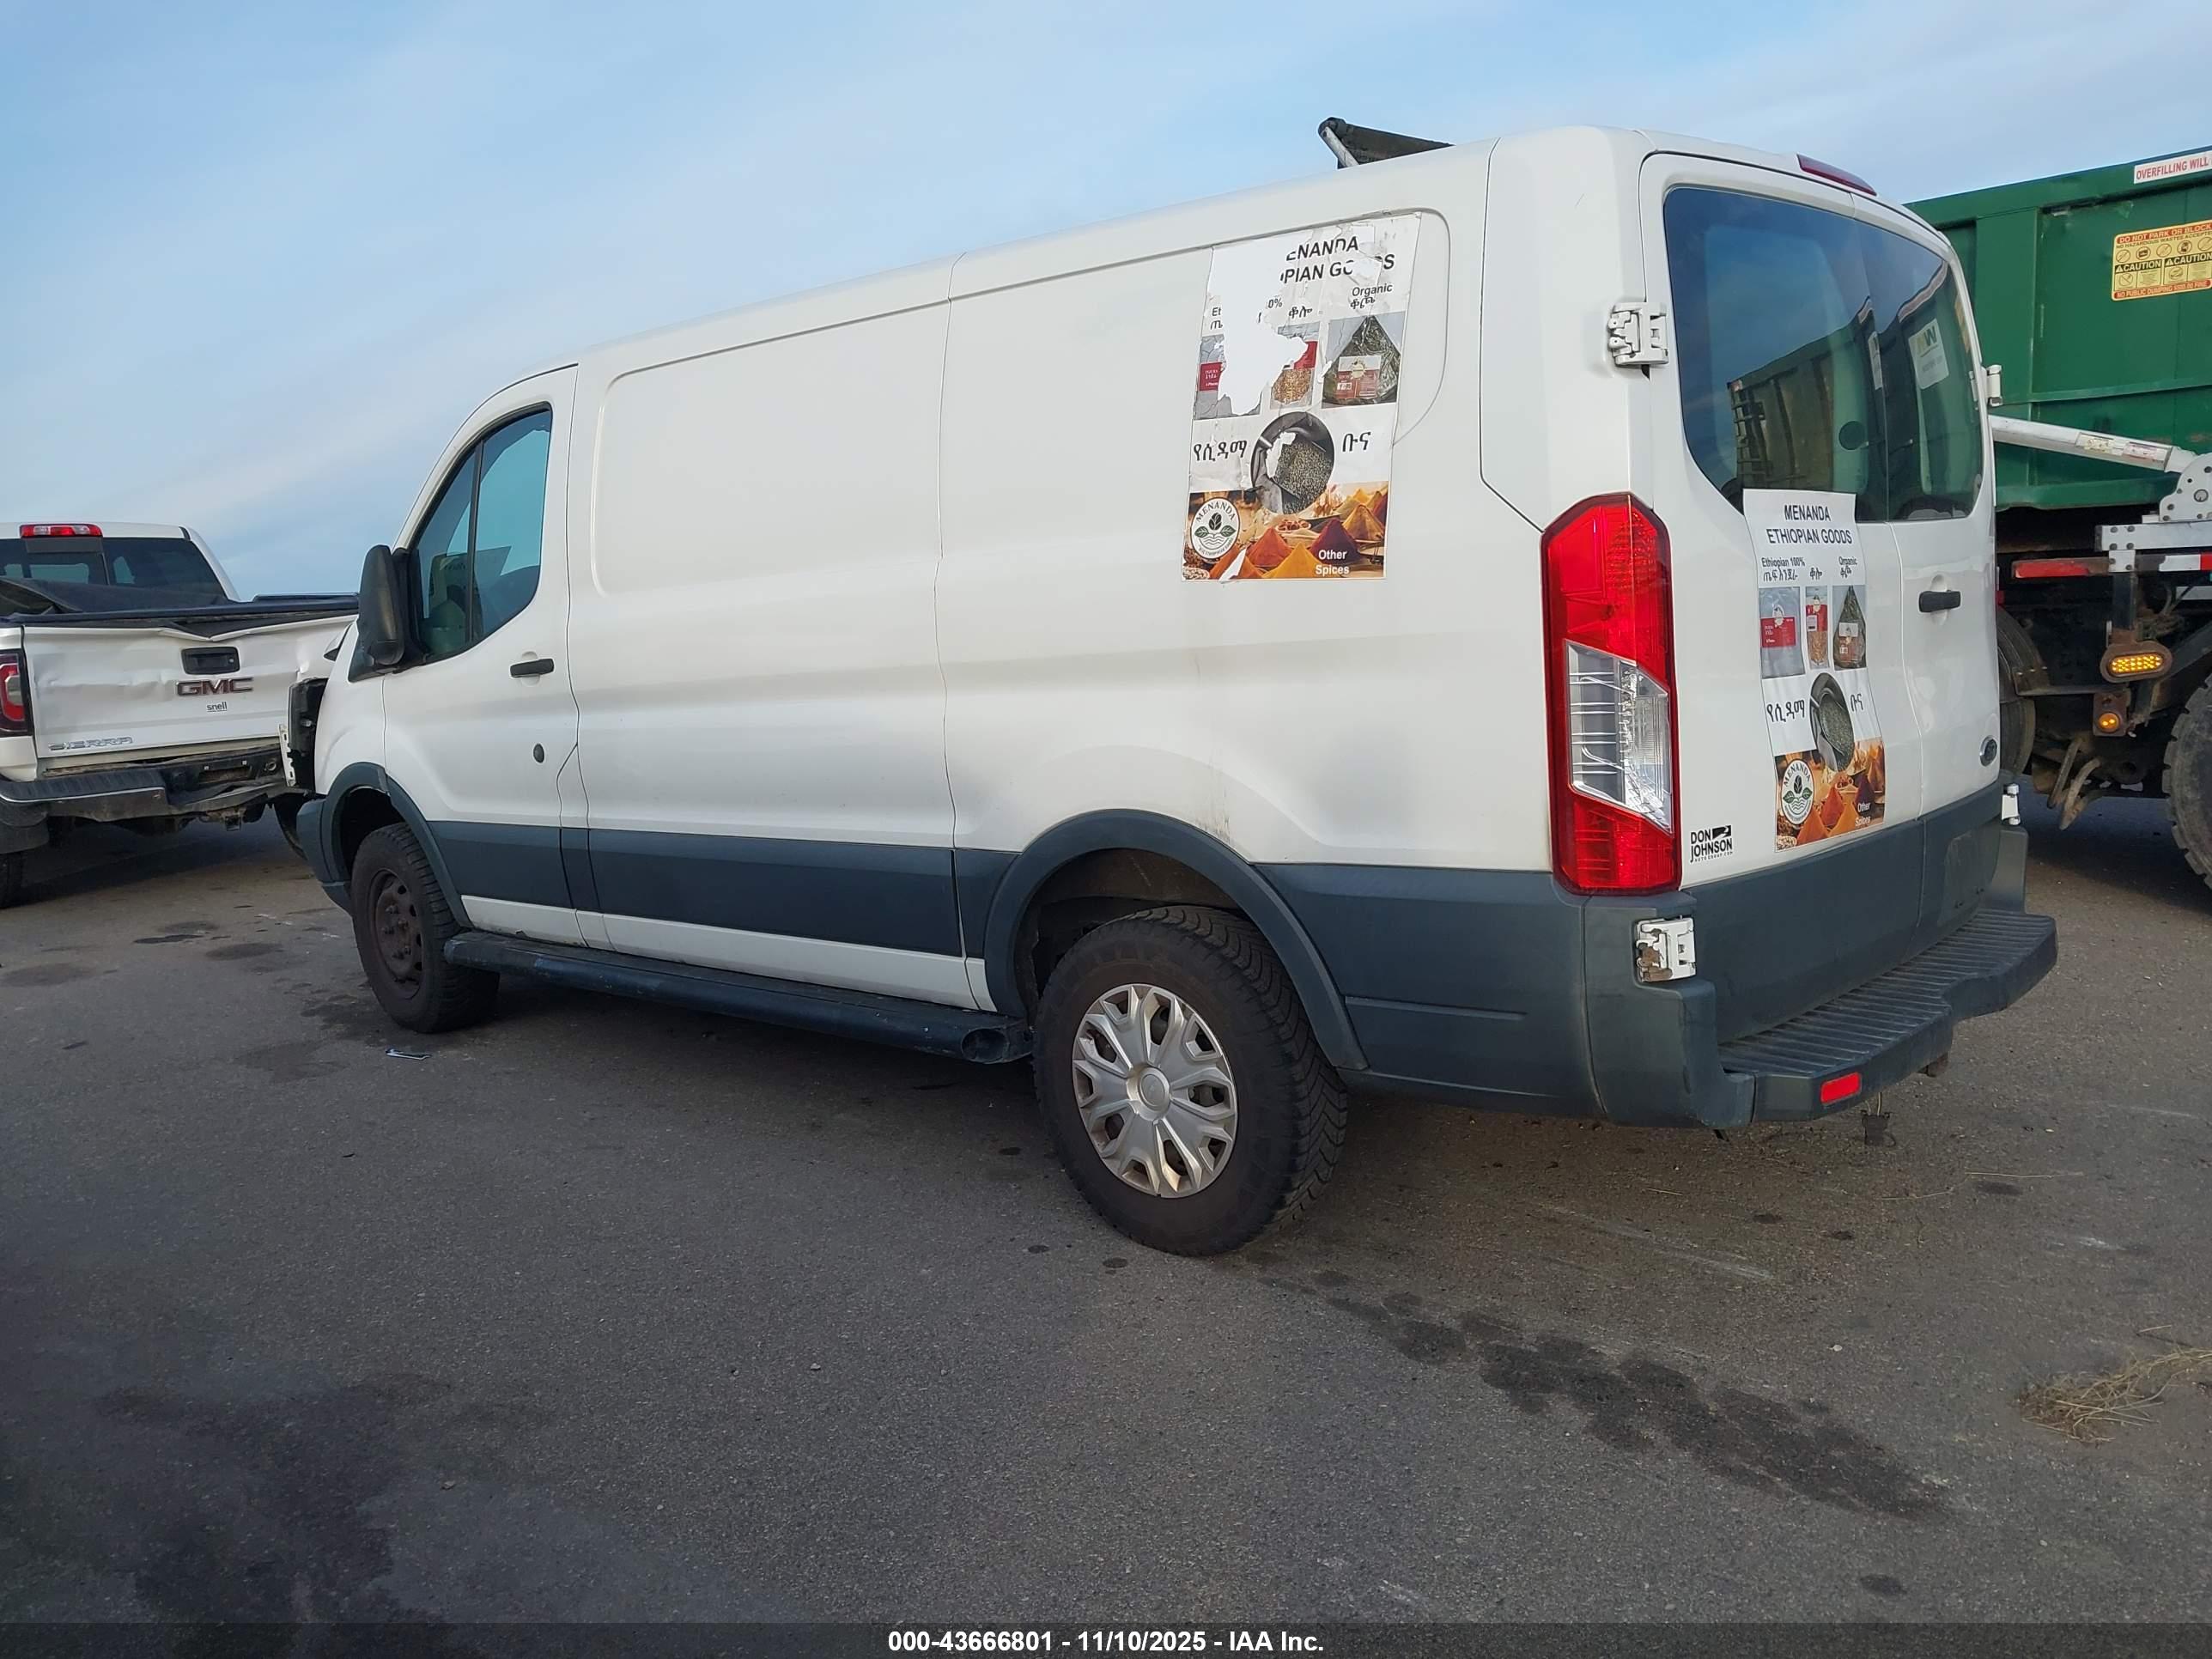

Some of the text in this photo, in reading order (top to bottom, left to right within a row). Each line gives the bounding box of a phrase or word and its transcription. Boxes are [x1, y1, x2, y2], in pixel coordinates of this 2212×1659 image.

[2136, 156, 2209, 179] OVERFILLING WILL
[2132, 234, 2148, 242] NOT
[2148, 230, 2169, 240] PARK
[2185, 223, 2212, 234] BLOCK
[2123, 259, 2161, 272] CAUTION
[2173, 252, 2212, 265] CAUTION
[1352, 283, 1393, 298] Organic
[1193, 431, 1372, 462] የሲዳማ ቡና
[1196, 501, 1236, 523] MENANDA
[1784, 504, 1832, 521] MENANDA
[1766, 528, 1852, 544] ETHIOPIAN GOODS
[1318, 549, 1347, 560] Other
[1315, 564, 1350, 575] Spices
[1761, 557, 1806, 568] Ethiopian 100%
[176, 678, 254, 696] GMC
[207, 701, 228, 711] snell
[1766, 693, 1863, 723] የሲዳማ ቡና
[49, 737, 133, 750] SIERRA
[1784, 763, 1811, 787] MENANDA
[1857, 801, 1871, 812] Other
[1855, 815, 1870, 827] Spices
[1690, 829, 1711, 844] DON
[1690, 837, 1733, 863] JOHNSON
